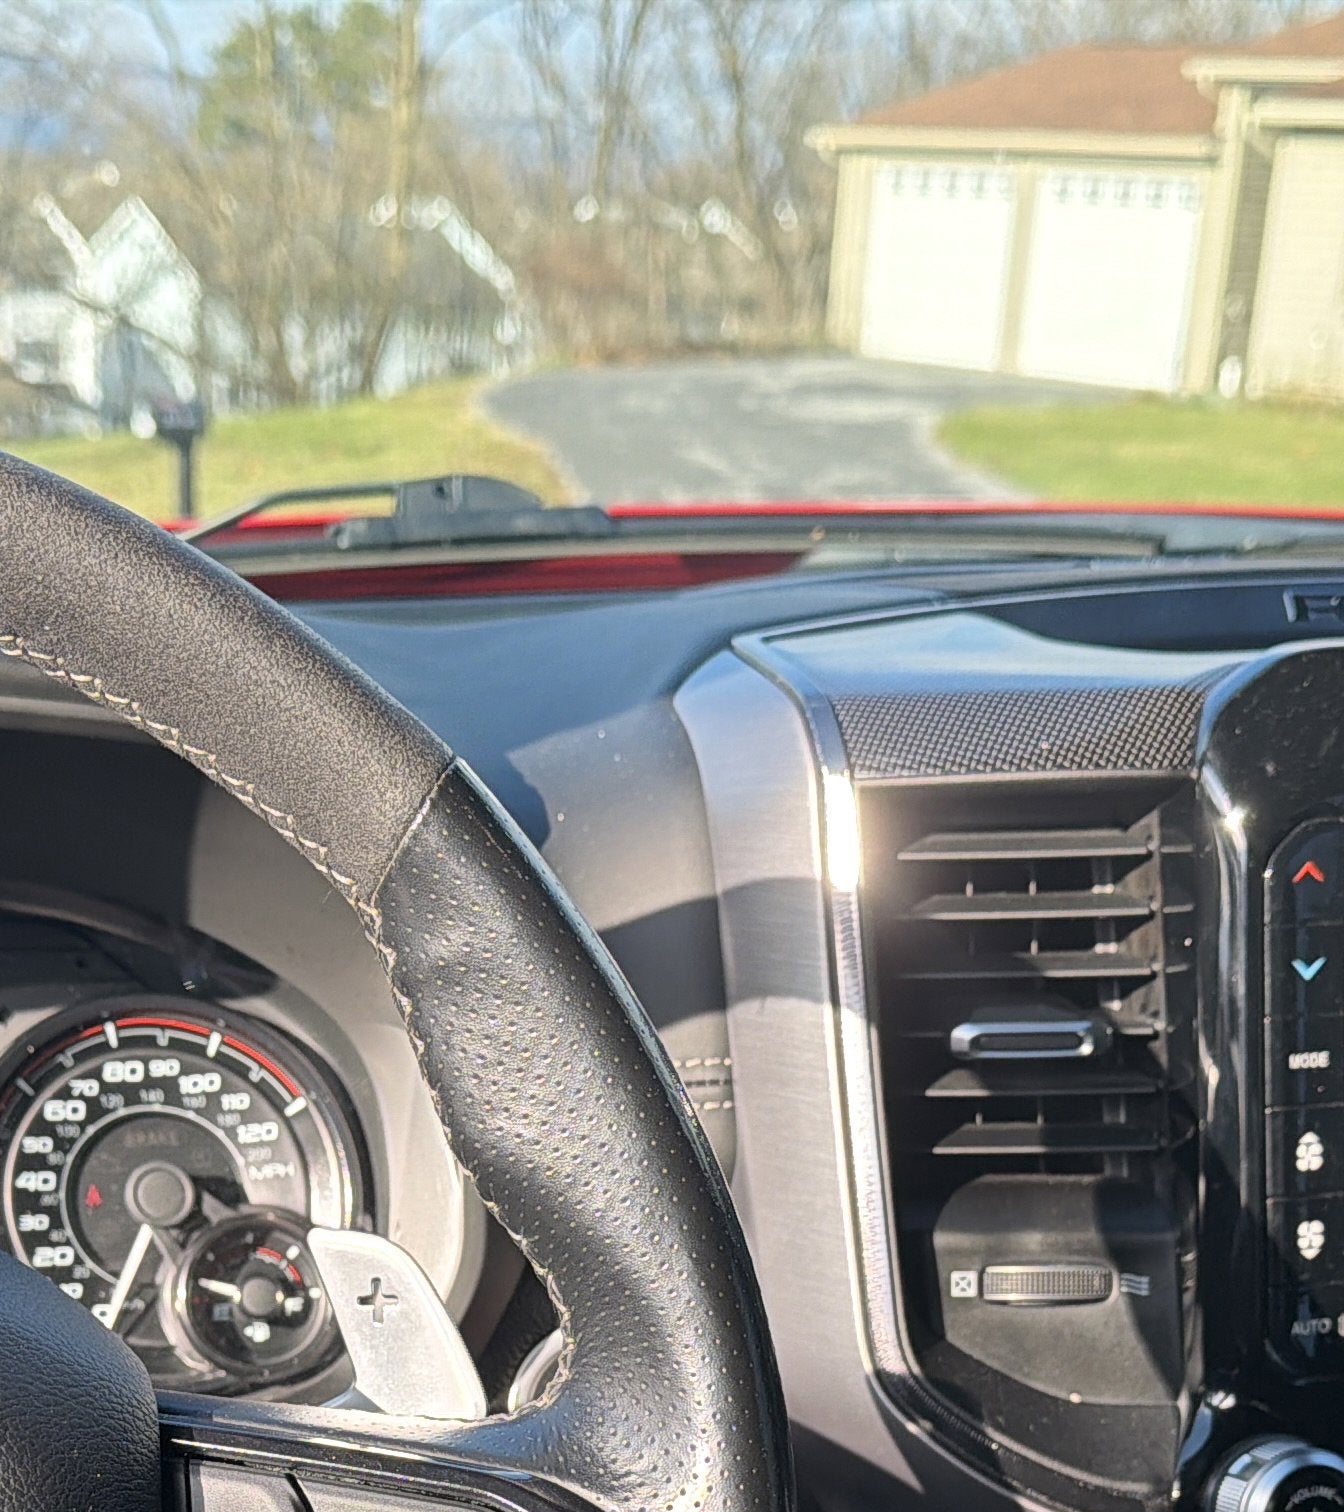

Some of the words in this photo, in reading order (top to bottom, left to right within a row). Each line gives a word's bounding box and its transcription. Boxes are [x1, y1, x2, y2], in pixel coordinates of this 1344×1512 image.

[148, 1058, 181, 1077] 90
[1288, 1050, 1330, 1070] MODE
[102, 1060, 144, 1083] 80
[69, 1078, 100, 1097] 70
[178, 1072, 222, 1095] 100
[43, 1099, 87, 1122] 60
[220, 1092, 251, 1111] 110
[236, 1121, 279, 1144] 120
[22, 1136, 54, 1154] 50
[14, 1170, 57, 1192] 40
[18, 1213, 50, 1231] 30
[32, 1245, 75, 1268] 20
[1290, 1317, 1333, 1335] AUTO
